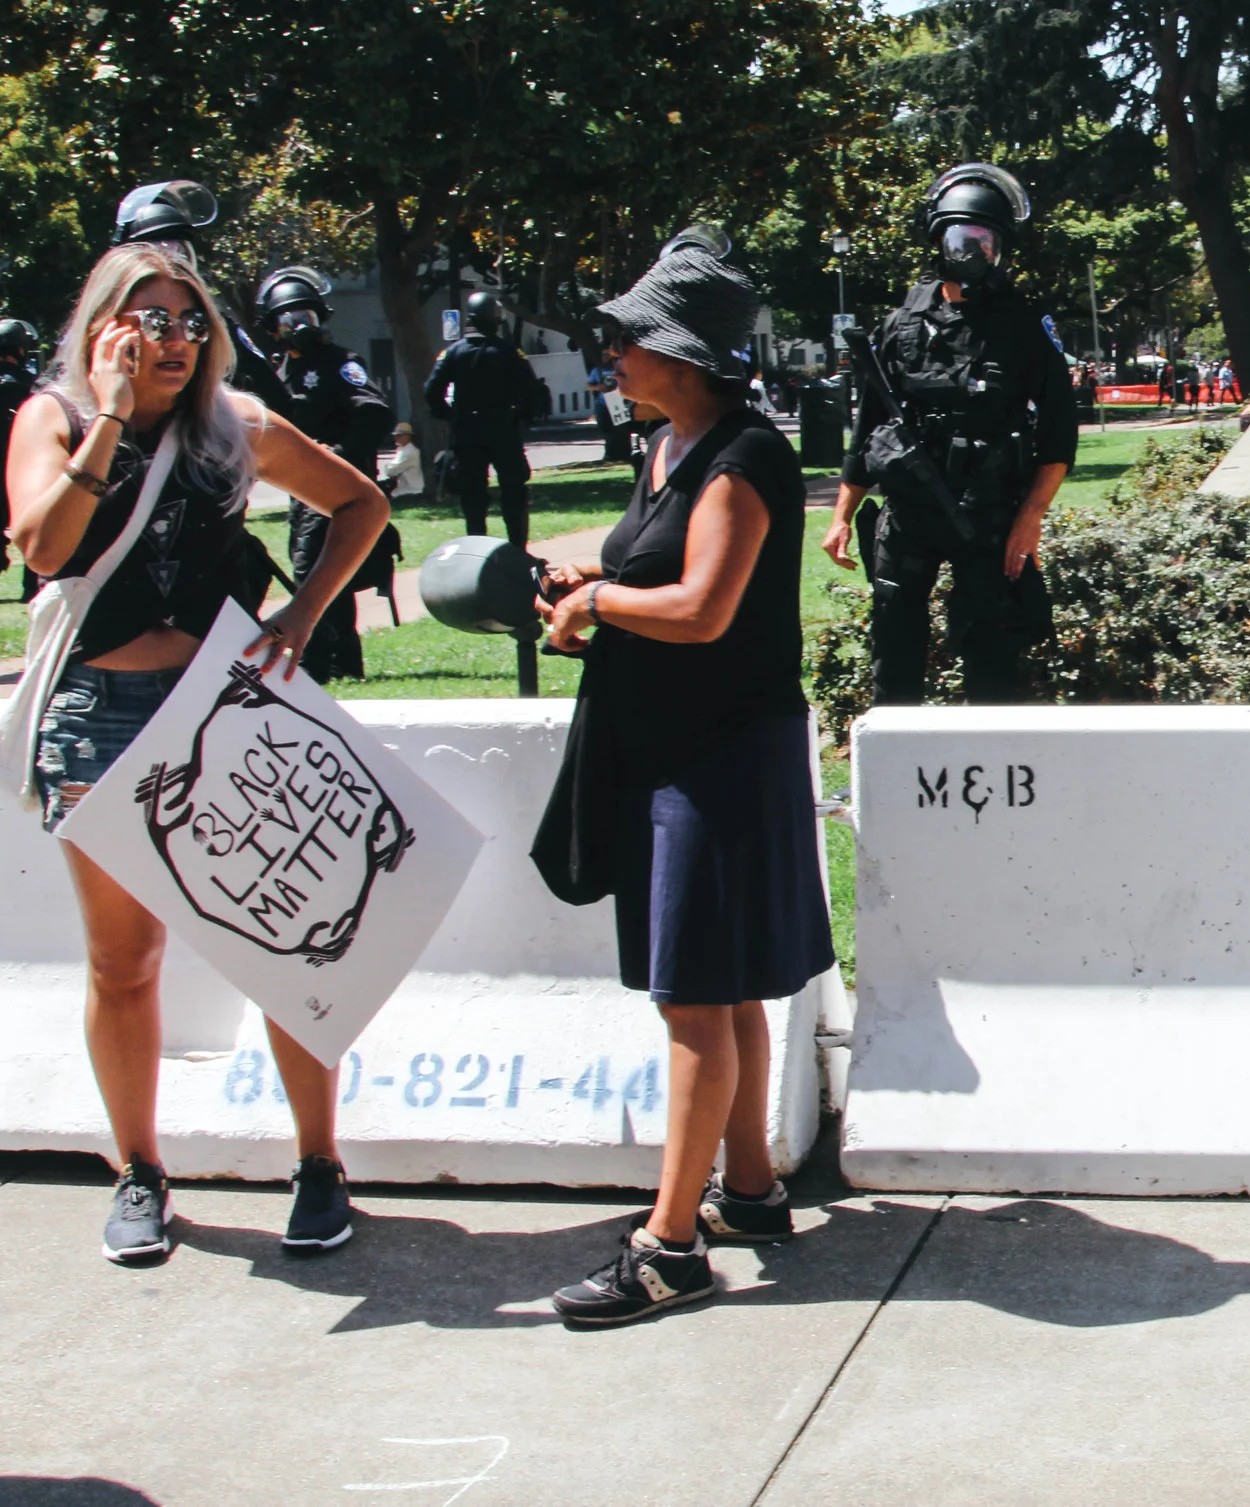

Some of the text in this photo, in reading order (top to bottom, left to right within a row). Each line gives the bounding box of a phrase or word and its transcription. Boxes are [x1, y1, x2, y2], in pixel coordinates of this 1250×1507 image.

[192, 721, 300, 857] BLACK
[210, 740, 342, 906] LIVES
[248, 770, 373, 938] MATTER
[225, 1048, 663, 1112] 8-821-44
